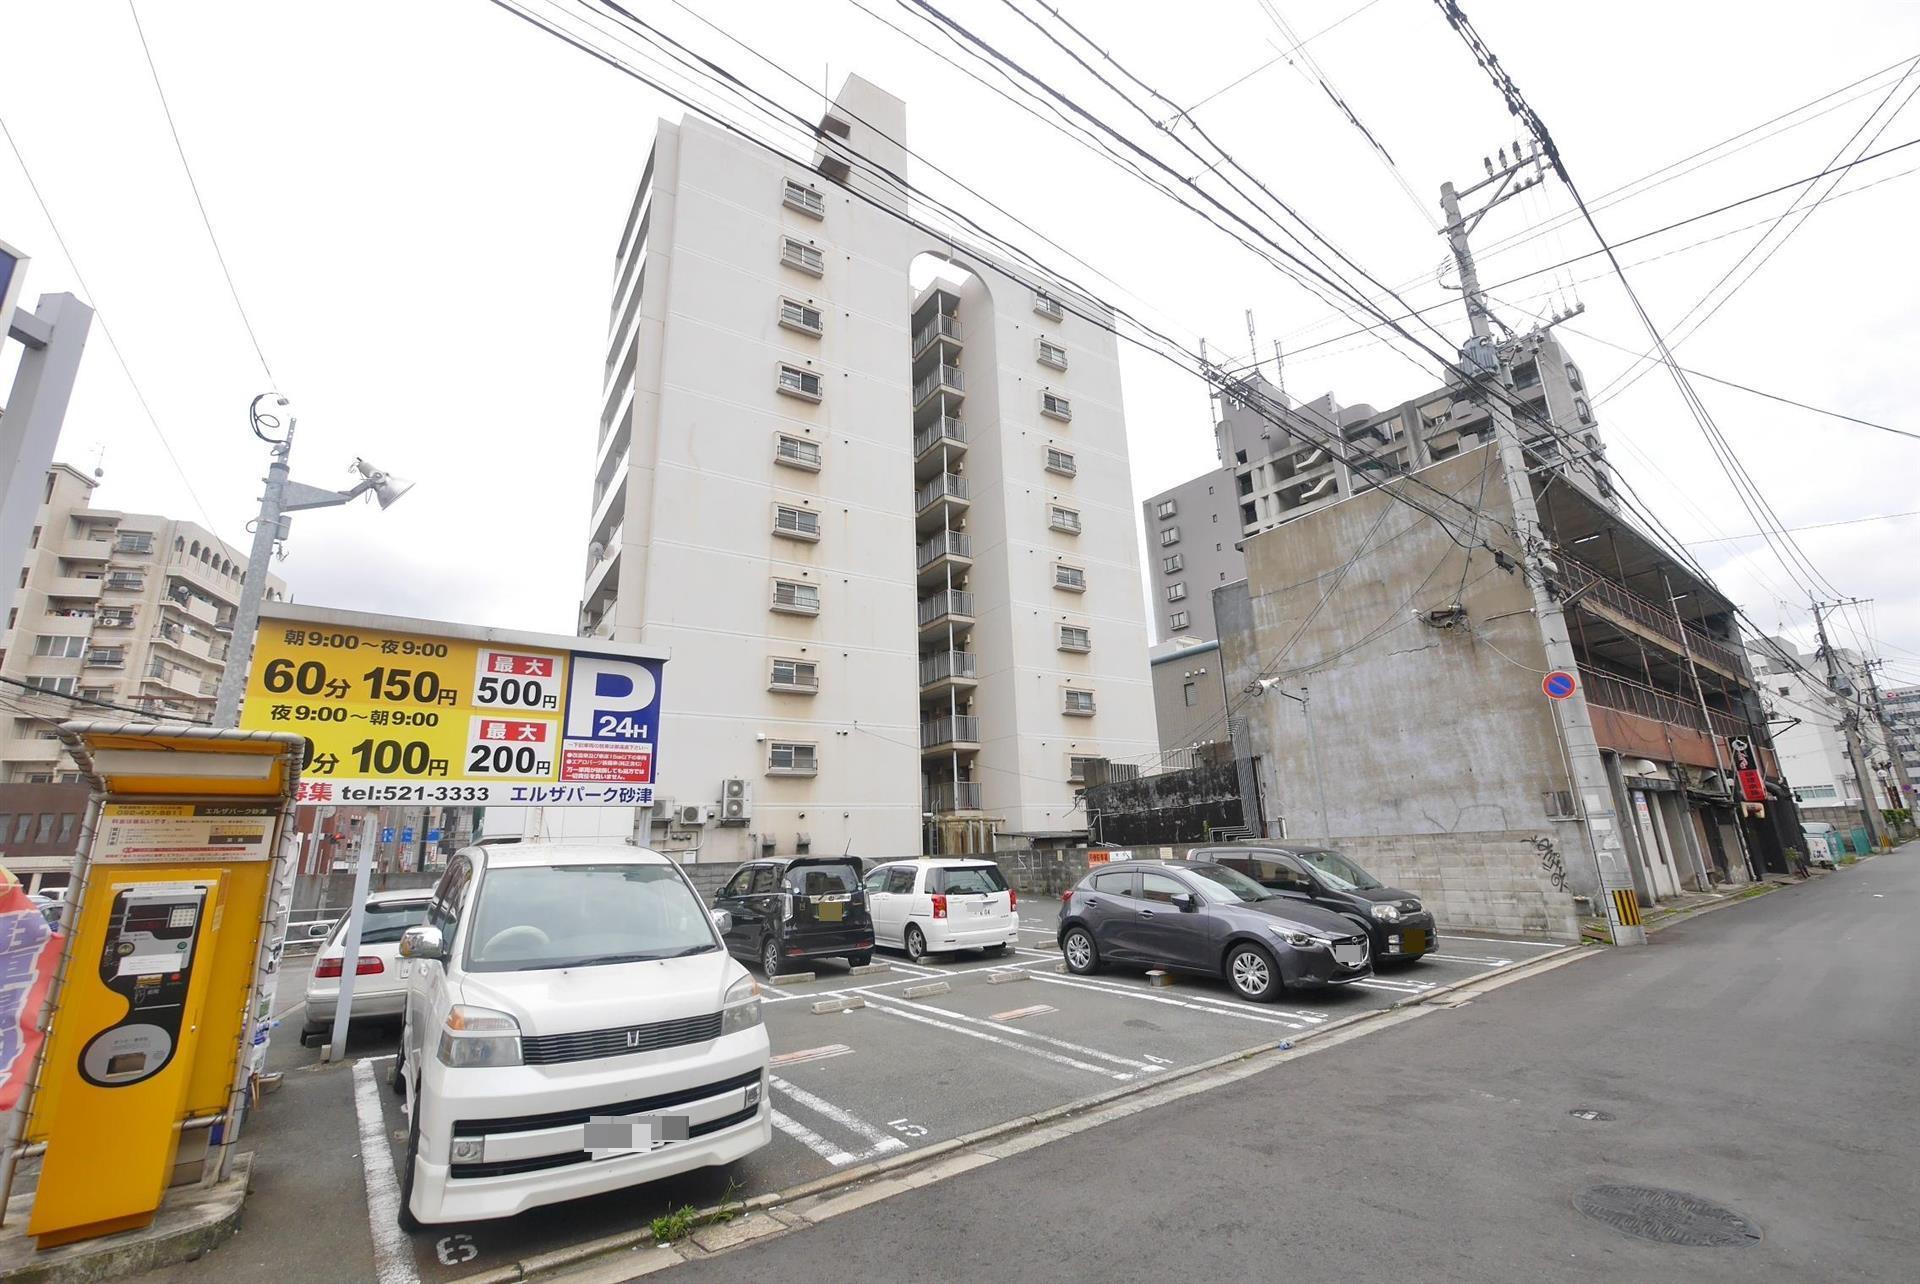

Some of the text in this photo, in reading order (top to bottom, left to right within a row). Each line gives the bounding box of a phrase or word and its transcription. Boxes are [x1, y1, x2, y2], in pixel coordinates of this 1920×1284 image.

[494, 656, 544, 675] 最大
[264, 658, 457, 706] 60分 150円
[477, 676, 557, 709] 500円
[567, 656, 656, 738] P
[486, 722, 537, 741] 最大
[598, 715, 648, 739] 24H
[352, 739, 449, 776] 100円
[468, 744, 550, 776] 200円
[342, 785, 489, 801] tel:521-3333
[510, 785, 652, 803] エルザパーク砂津
[436, 1234, 479, 1265] 6
